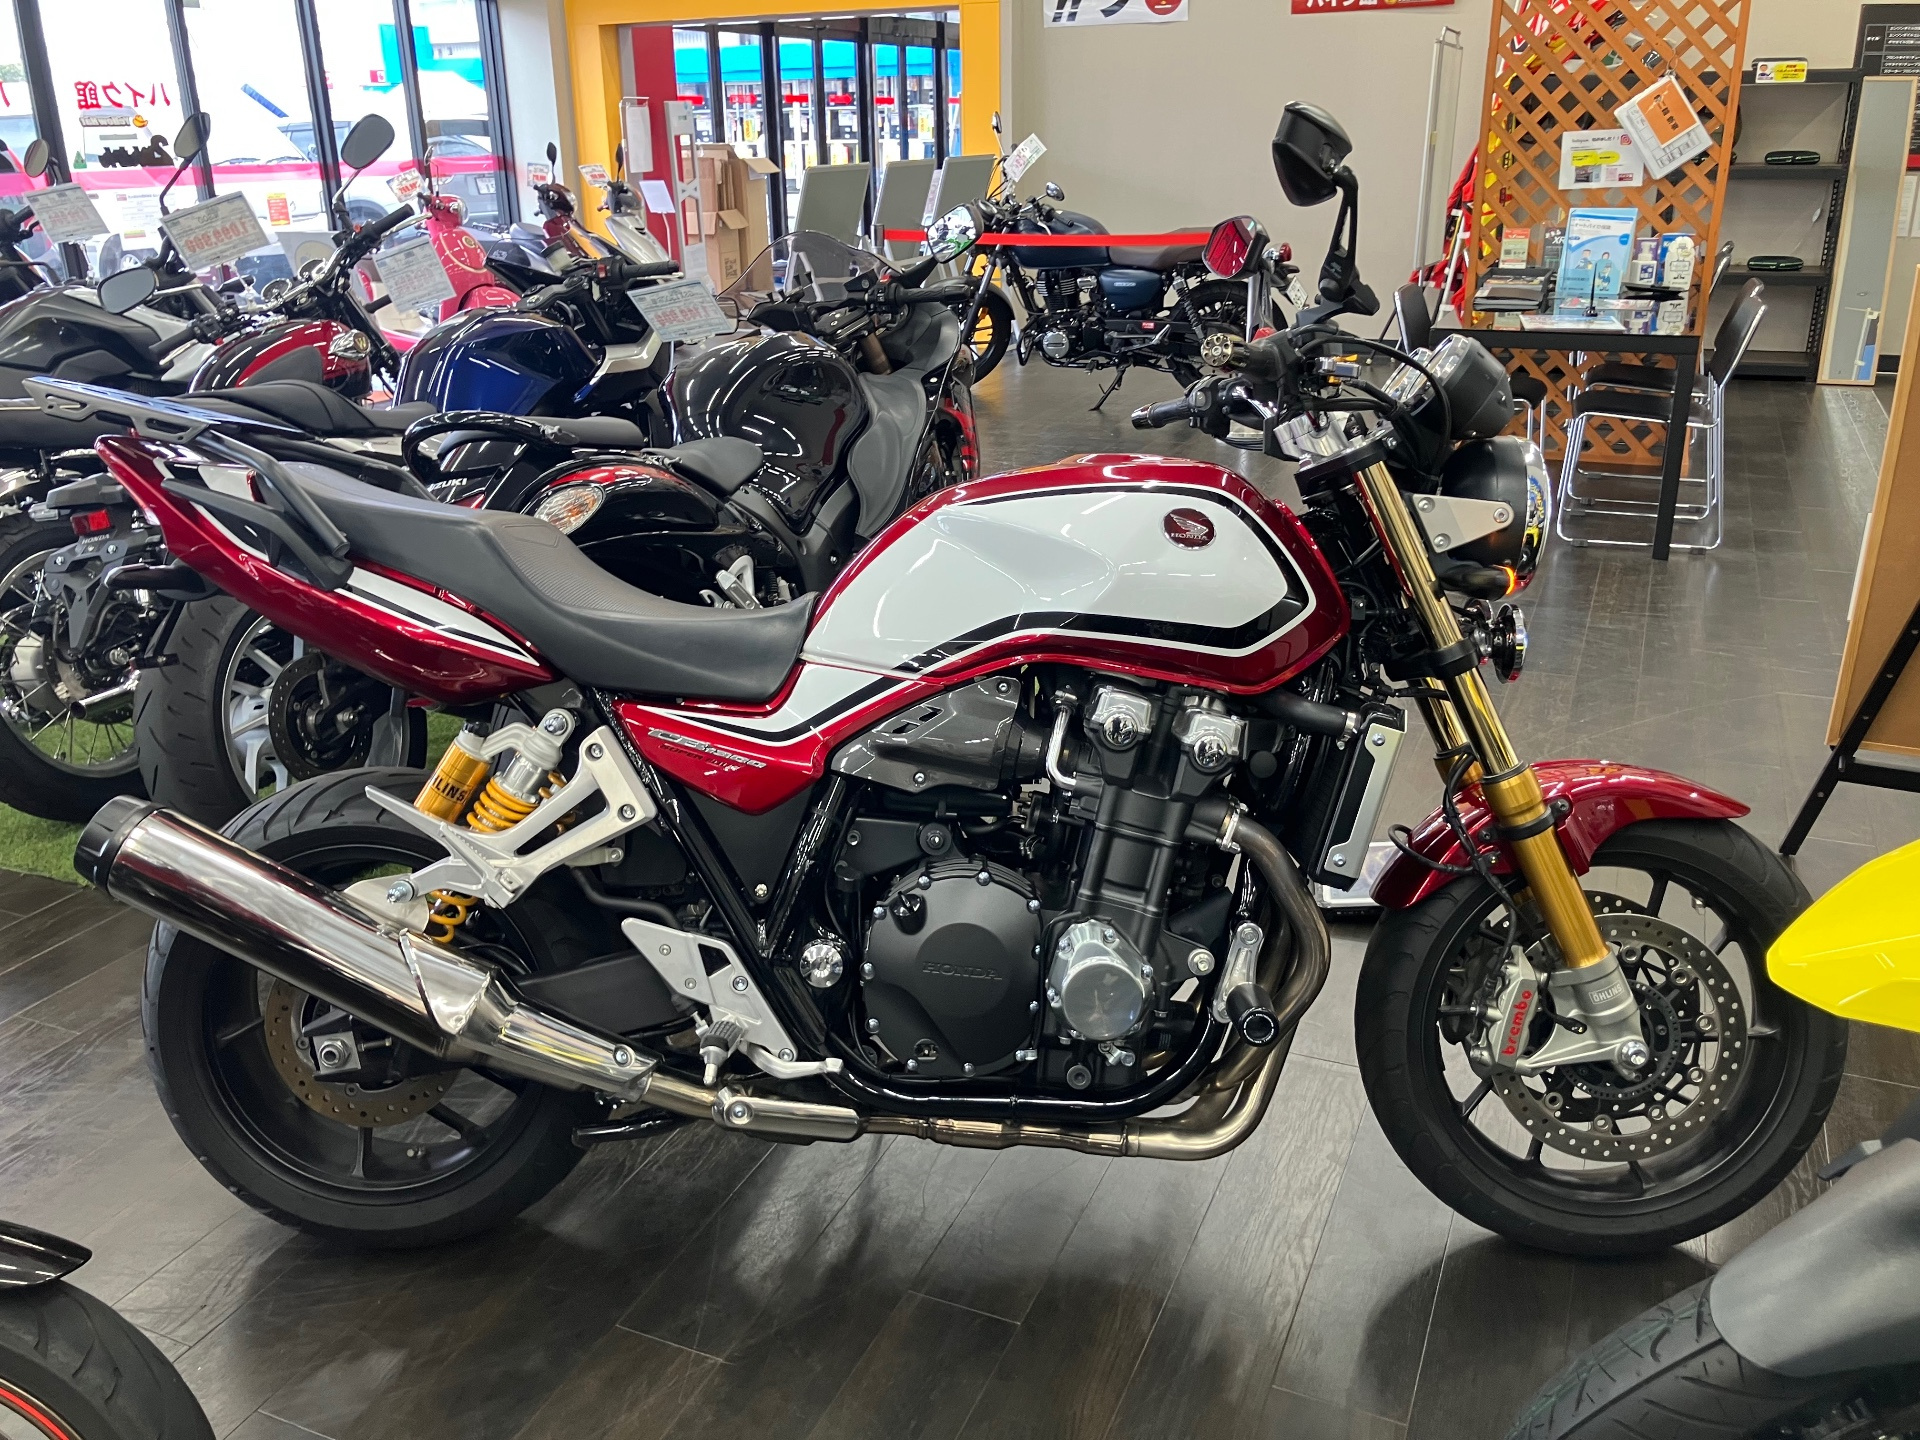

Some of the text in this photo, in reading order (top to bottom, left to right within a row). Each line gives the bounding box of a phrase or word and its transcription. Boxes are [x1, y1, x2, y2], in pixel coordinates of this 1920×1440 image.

[81, 533, 110, 545] HONDA
[1170, 532, 1210, 541] HONDA
[922, 961, 1003, 981] HONDA
[1592, 982, 1623, 1002] ÖHLINS
[1501, 989, 1533, 1056] brembo
